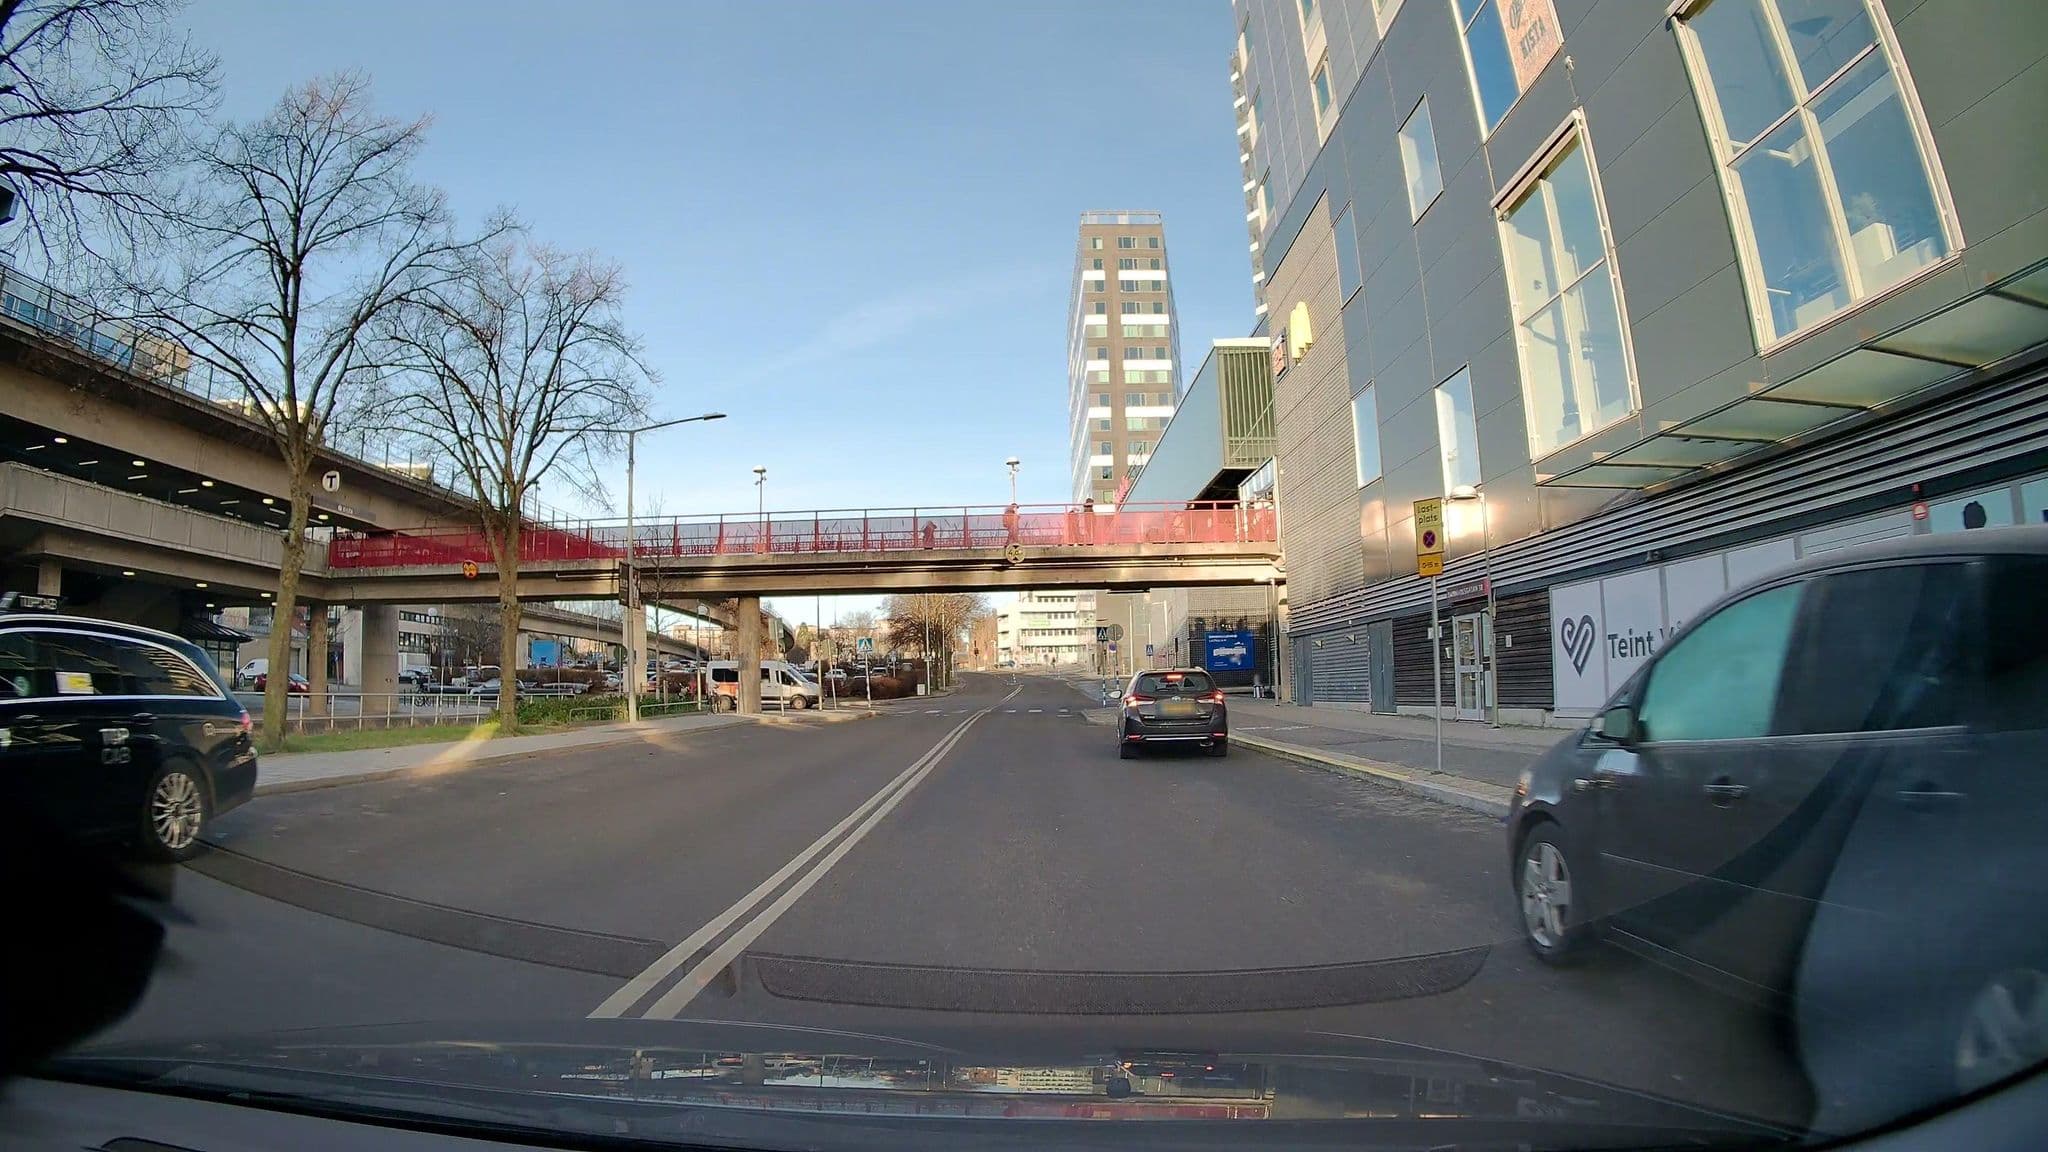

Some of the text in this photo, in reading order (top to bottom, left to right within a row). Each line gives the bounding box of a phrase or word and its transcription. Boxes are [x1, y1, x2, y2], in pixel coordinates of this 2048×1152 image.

[1417, 504, 1438, 514] Last-
[1418, 514, 1438, 525] plats
[1607, 628, 1656, 659] Teint
